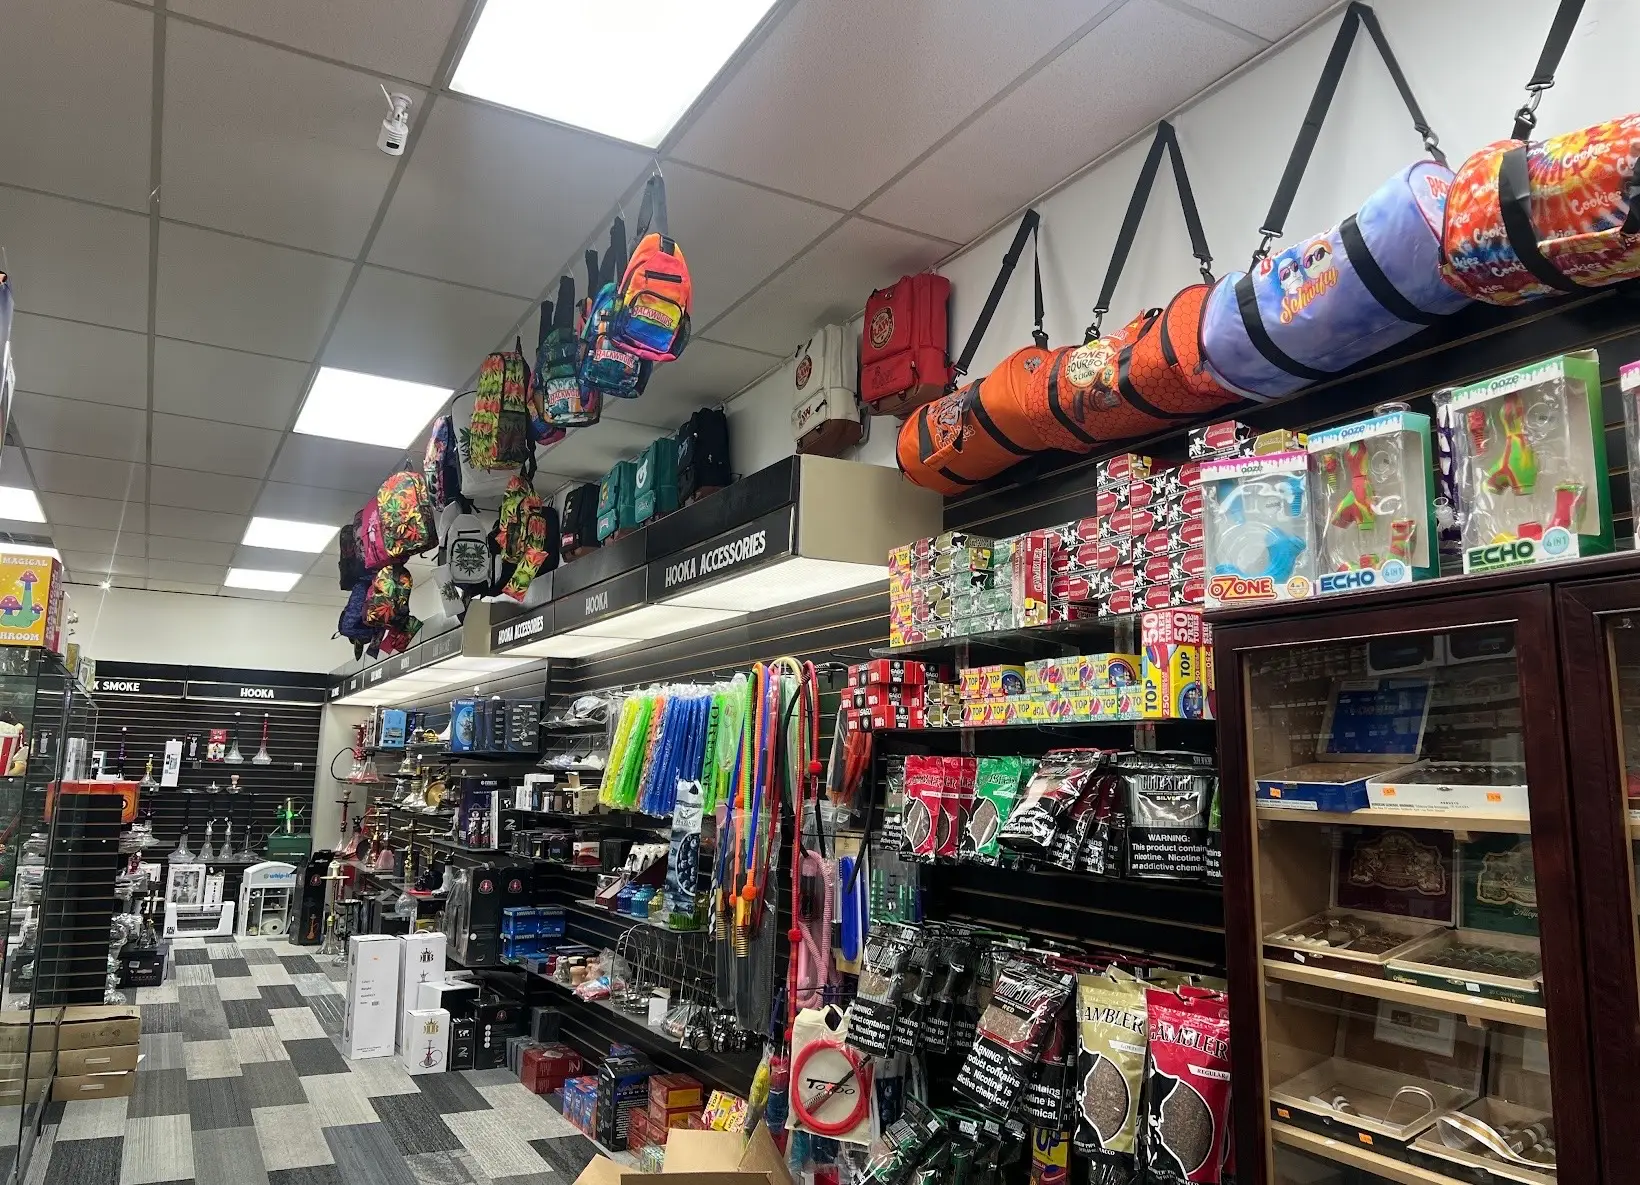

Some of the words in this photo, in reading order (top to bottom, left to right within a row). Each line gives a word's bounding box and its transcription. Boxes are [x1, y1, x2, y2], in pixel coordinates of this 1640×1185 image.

[1562, 141, 1613, 169] Cookies
[1571, 189, 1622, 216] Cookies
[630, 304, 674, 328] BACKWOODS
[593, 349, 635, 369] BACKWOODS
[1069, 350, 1110, 362] HONEY
[1491, 374, 1520, 391] ooze
[1341, 424, 1366, 438] ooze
[1240, 463, 1264, 474] ooze
[1546, 540, 1553, 548] 4
[664, 557, 697, 588] HOOKA
[699, 529, 767, 576] ACCESSORIES
[898, 552, 910, 563] TOP
[1468, 540, 1535, 568] ECHO
[2, 556, 49, 567] MAGICAL
[1320, 570, 1375, 592] ECHO
[585, 591, 609, 616] HOOKA
[899, 604, 910, 615] TOP
[498, 626, 514, 645] HOOKA
[514, 615, 545, 639] ACCESSORIES
[1143, 612, 1159, 644] 50
[1173, 612, 1188, 643] 50
[0, 632, 40, 641] HROOM
[1066, 665, 1078, 676] TOP
[1181, 651, 1191, 678] TOP
[968, 675, 979, 686] TOP
[990, 674, 1001, 684] TOP
[102, 681, 141, 693] SMOKE
[240, 687, 275, 699] HOOKA
[1145, 679, 1157, 712] TOP
[1018, 703, 1031, 714] TOP
[1074, 698, 1088, 710] TOP
[1103, 697, 1116, 709] TOP
[1162, 695, 1170, 716] 250
[972, 707, 983, 717] TOP
[993, 706, 1005, 716] TOP
[1147, 833, 1191, 843] WARNING:
[1132, 843, 1146, 851] This
[1146, 844, 1177, 854] product
[1178, 844, 1208, 853] contain
[1134, 853, 1165, 861] nicotine.
[1168, 853, 1202, 862] Nicotine
[1139, 862, 1175, 871] addictive
[1176, 863, 1208, 872] chemic
[1001, 1003, 1015, 1014] RED
[862, 1017, 891, 1031] contains
[1081, 1006, 1145, 1037] AMBLER
[878, 1031, 886, 1040] is
[906, 1029, 914, 1037] is
[975, 1043, 1004, 1065] ARNING:
[985, 1061, 1021, 1089] contains
[973, 1069, 1003, 1091] Nicotine
[1003, 1085, 1013, 1097] is
[1026, 1082, 1061, 1097] ontains
[1047, 1097, 1056, 1108] is
